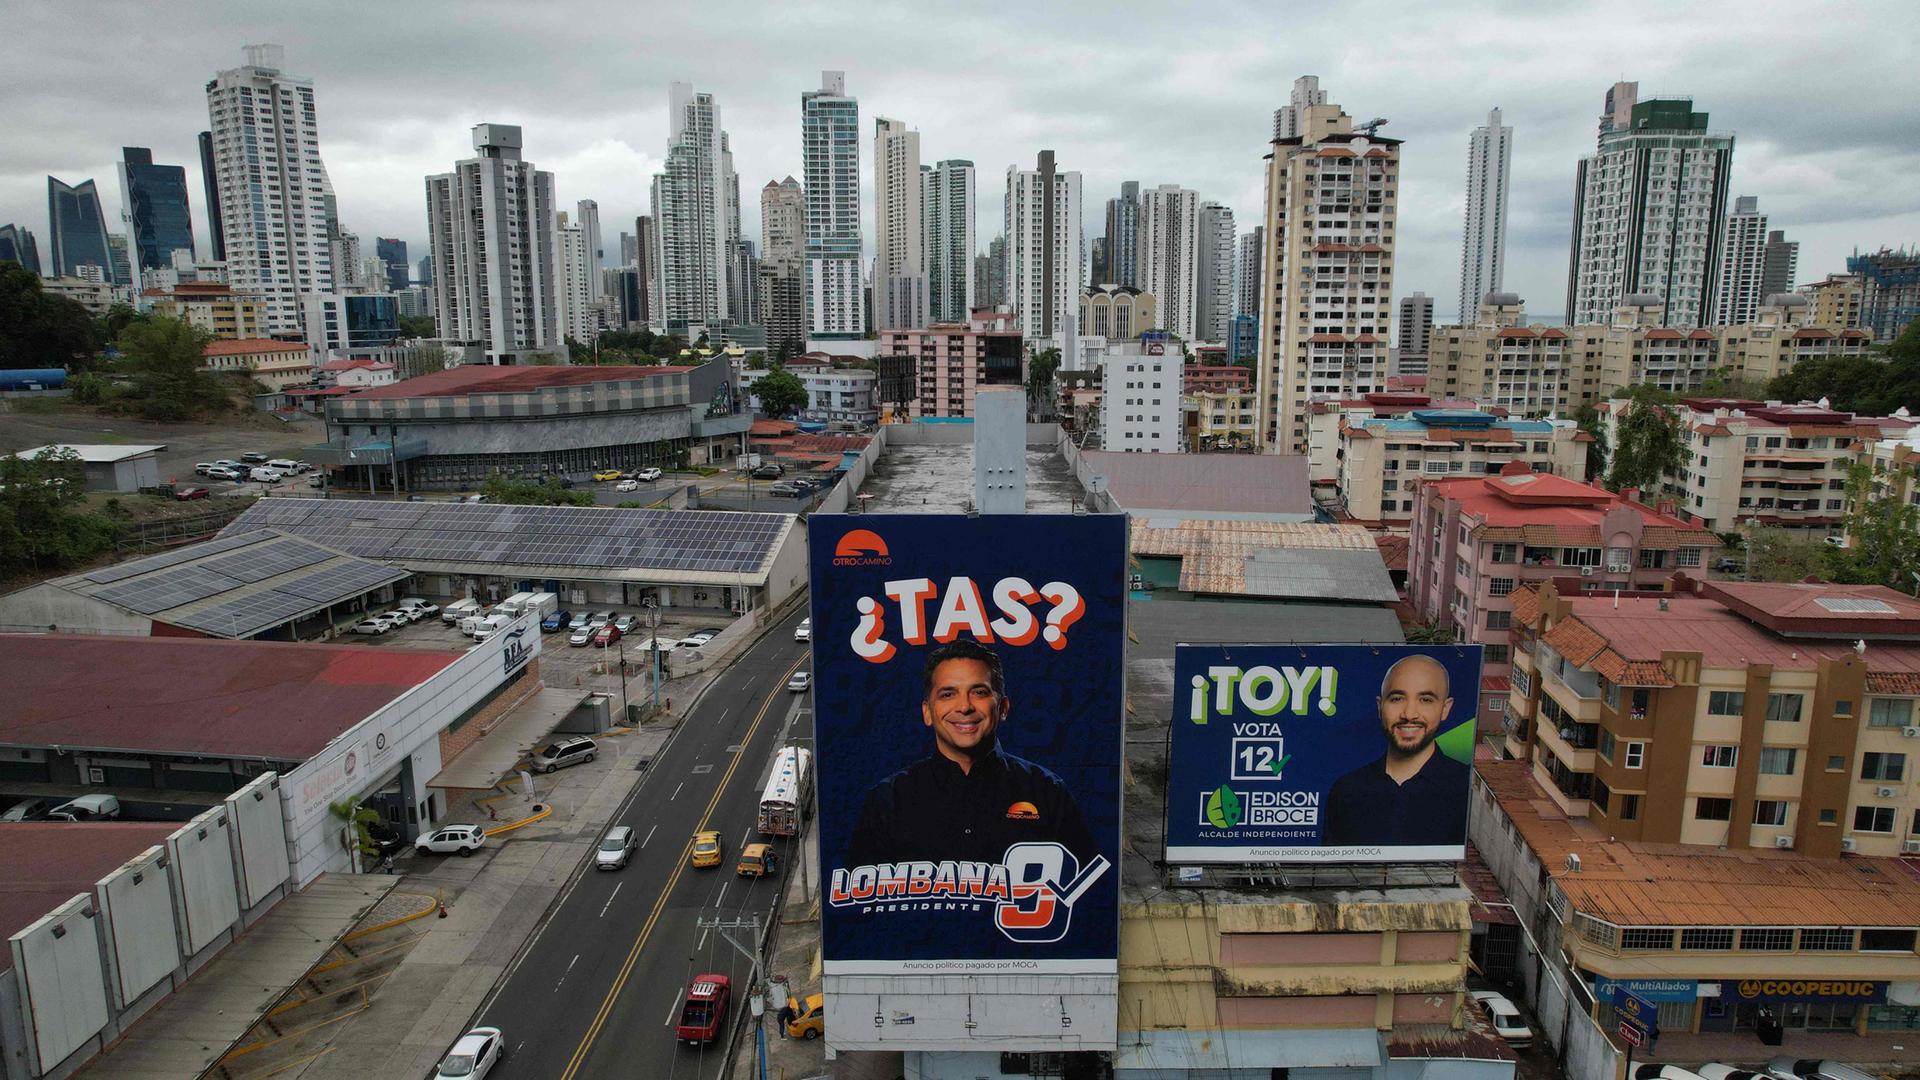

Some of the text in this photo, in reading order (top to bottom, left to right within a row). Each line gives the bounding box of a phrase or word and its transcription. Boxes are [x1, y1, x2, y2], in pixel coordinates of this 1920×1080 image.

[832, 557, 893, 566] OTROCAMINO
[850, 576, 1087, 664] ¿TAS?
[1190, 665, 1339, 725] ¡TOY!
[1232, 722, 1283, 737] VOTA
[1239, 746, 1276, 773] 12
[1250, 791, 1320, 807] EDISON
[1253, 809, 1315, 823] BROCE
[1249, 849, 1280, 857] Anuncio
[1311, 849, 1341, 858] pagado
[1341, 849, 1356, 858] por
[1356, 848, 1382, 856] MOCA
[829, 842, 1080, 943] LOMBANA 9
[862, 902, 981, 914] PRESIDENTE
[902, 962, 934, 970] Anuncio
[965, 961, 996, 970] pagado
[996, 961, 1012, 970] por
[1012, 961, 1039, 969] MOCA
[1629, 981, 1691, 991] MultiAliados
[1762, 981, 1874, 996] COOPEDUC
